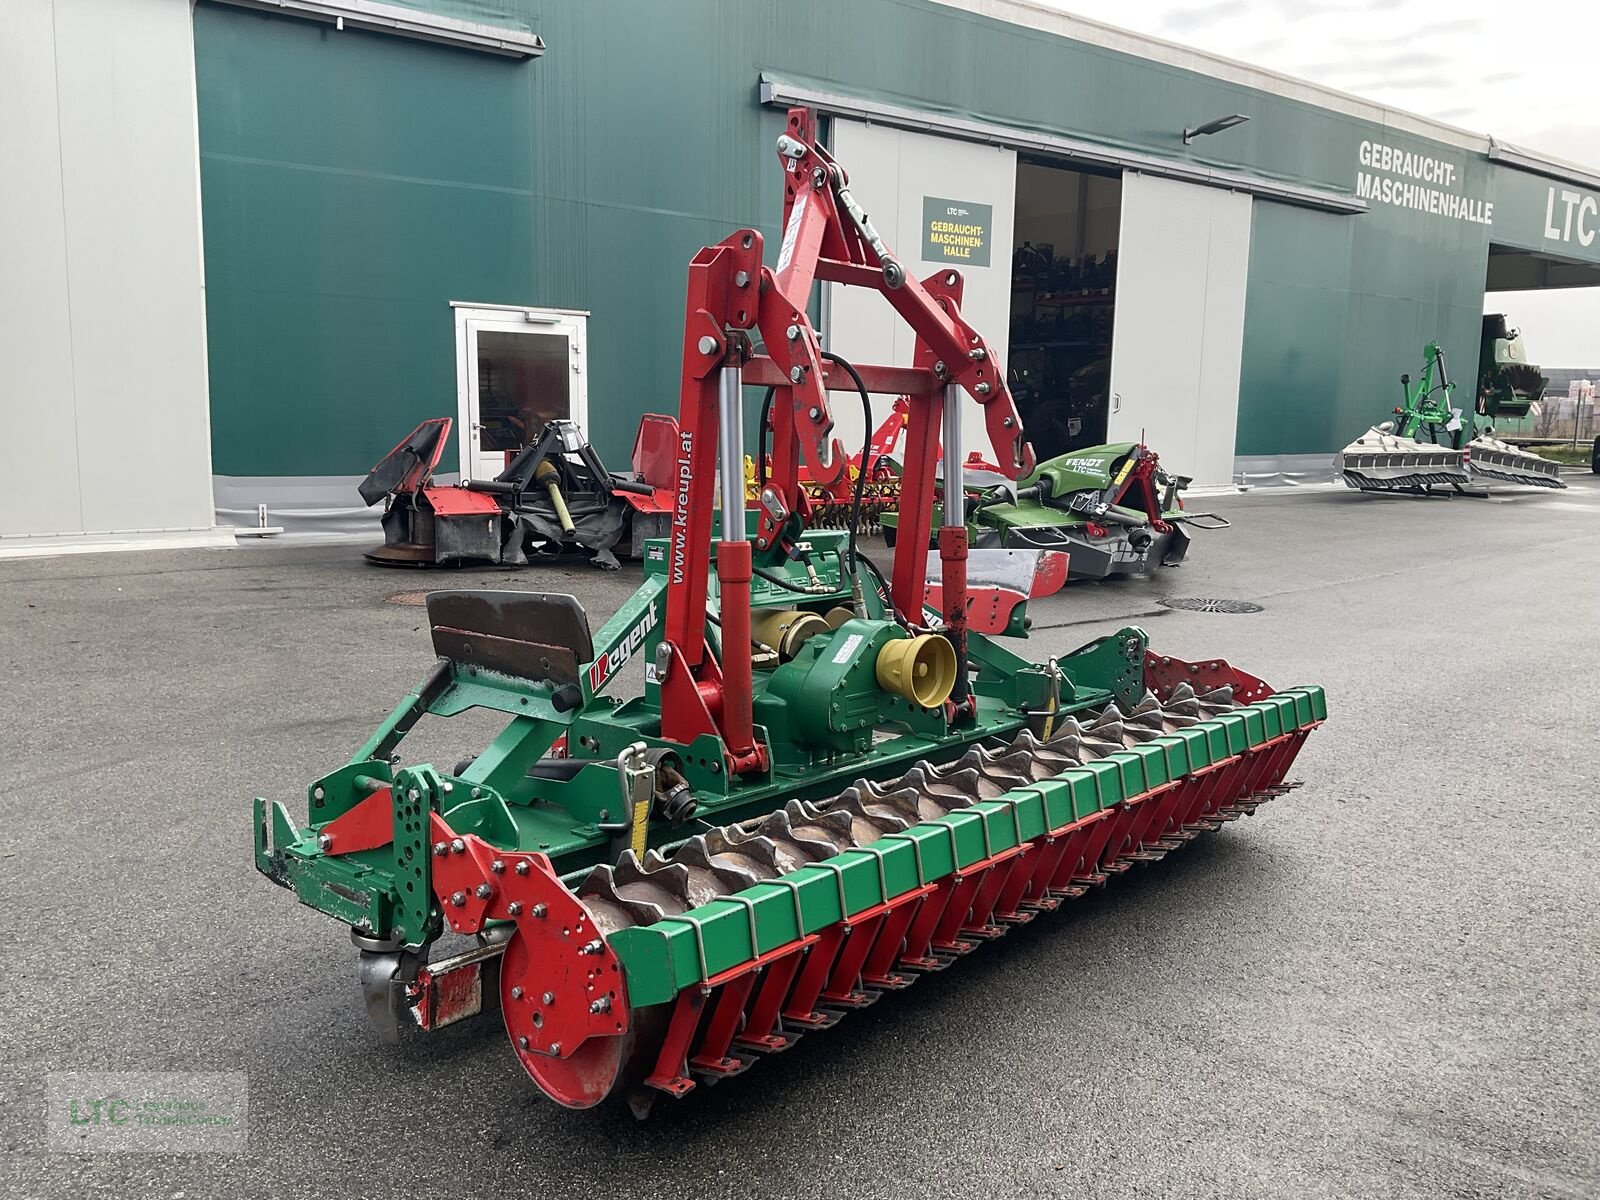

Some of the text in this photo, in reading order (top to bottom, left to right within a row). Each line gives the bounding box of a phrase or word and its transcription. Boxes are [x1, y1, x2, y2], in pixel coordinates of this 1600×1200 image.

[1359, 140, 1456, 187] GEBRAUCHT-
[947, 207, 958, 216] LTC
[1356, 171, 1493, 225] MASCHINENHALLE
[931, 221, 983, 236] GEBRAUCHT-
[1544, 187, 1597, 247] LTC
[930, 232, 983, 247] MASCHINEN-
[944, 245, 970, 258] HALLE
[1065, 458, 1105, 467] FENDT
[673, 431, 693, 584] www.kreupl.at
[589, 600, 658, 693] Regent
